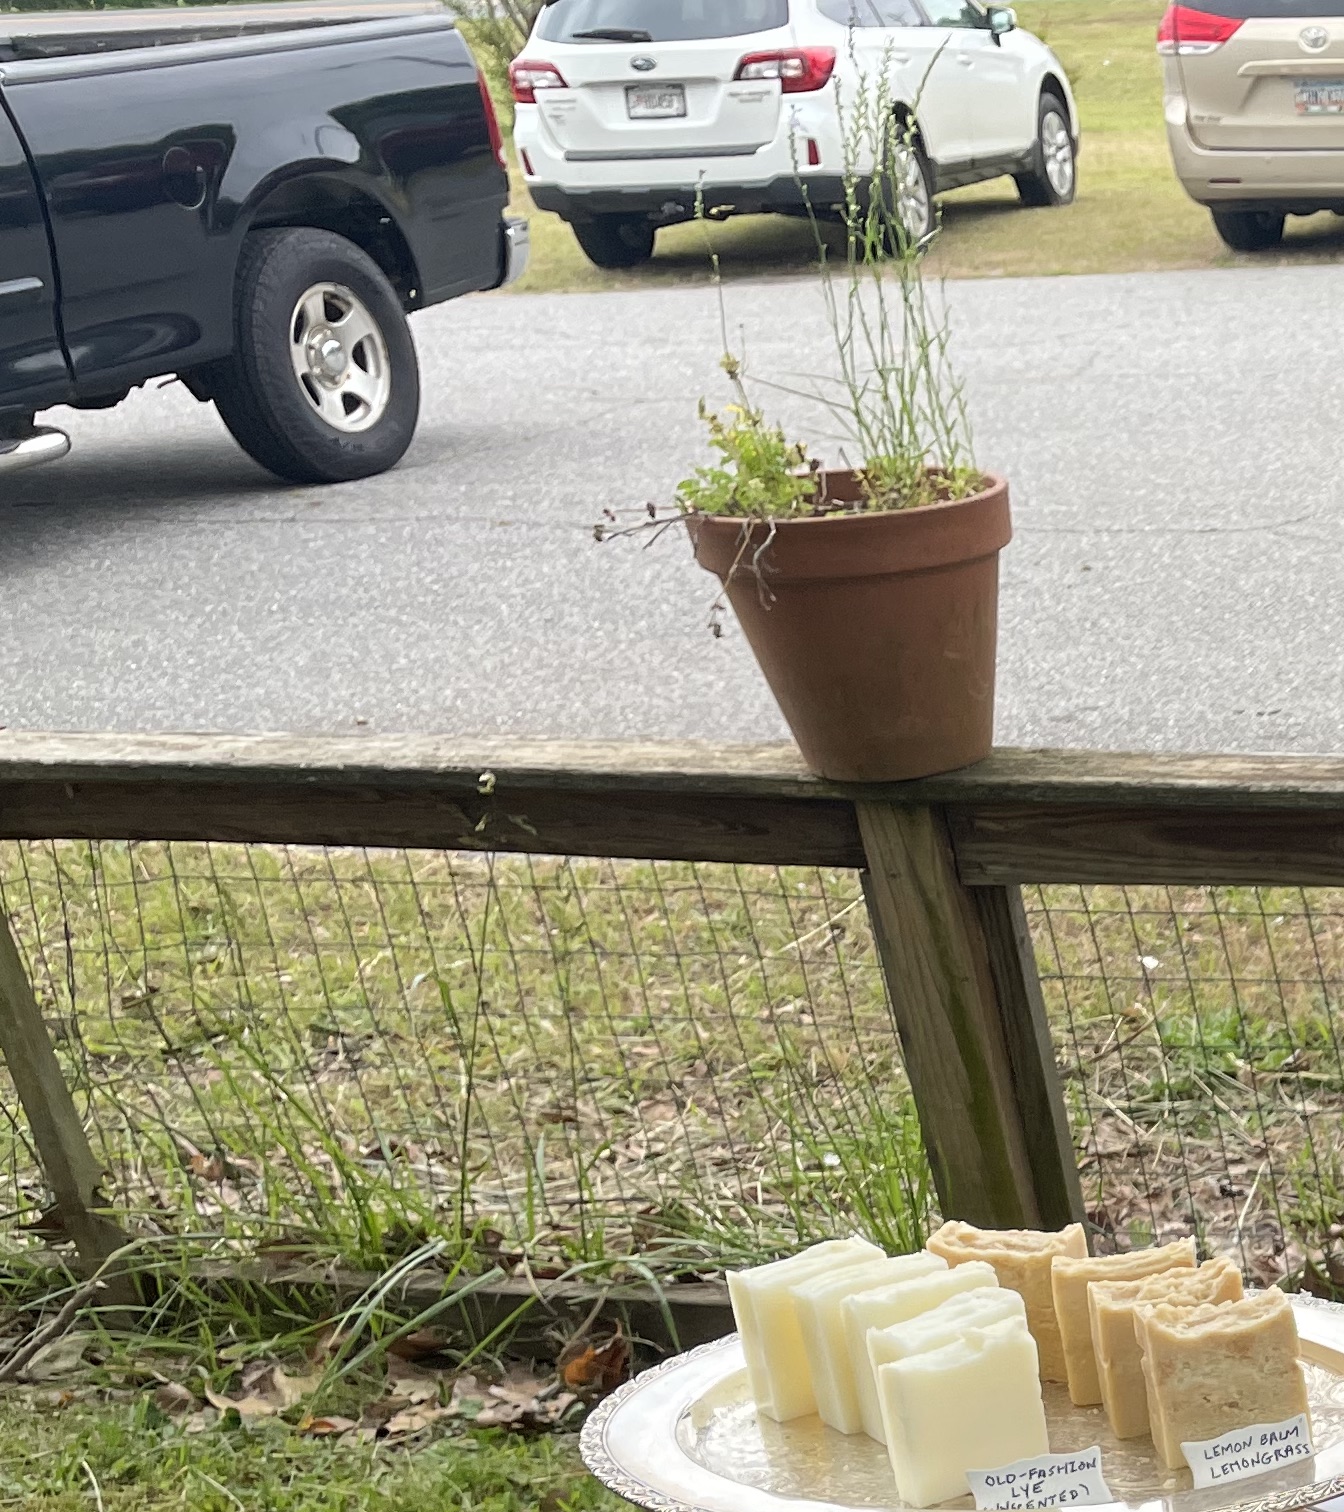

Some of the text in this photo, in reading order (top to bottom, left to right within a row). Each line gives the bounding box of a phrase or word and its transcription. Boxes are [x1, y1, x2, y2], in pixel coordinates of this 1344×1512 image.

[1204, 1426, 1299, 1460] LEMON BALM
[985, 1457, 1096, 1487] OLD-FASHION
[1210, 1443, 1310, 1479] LEMONGRASS
[1012, 1480, 1044, 1499] LYE
